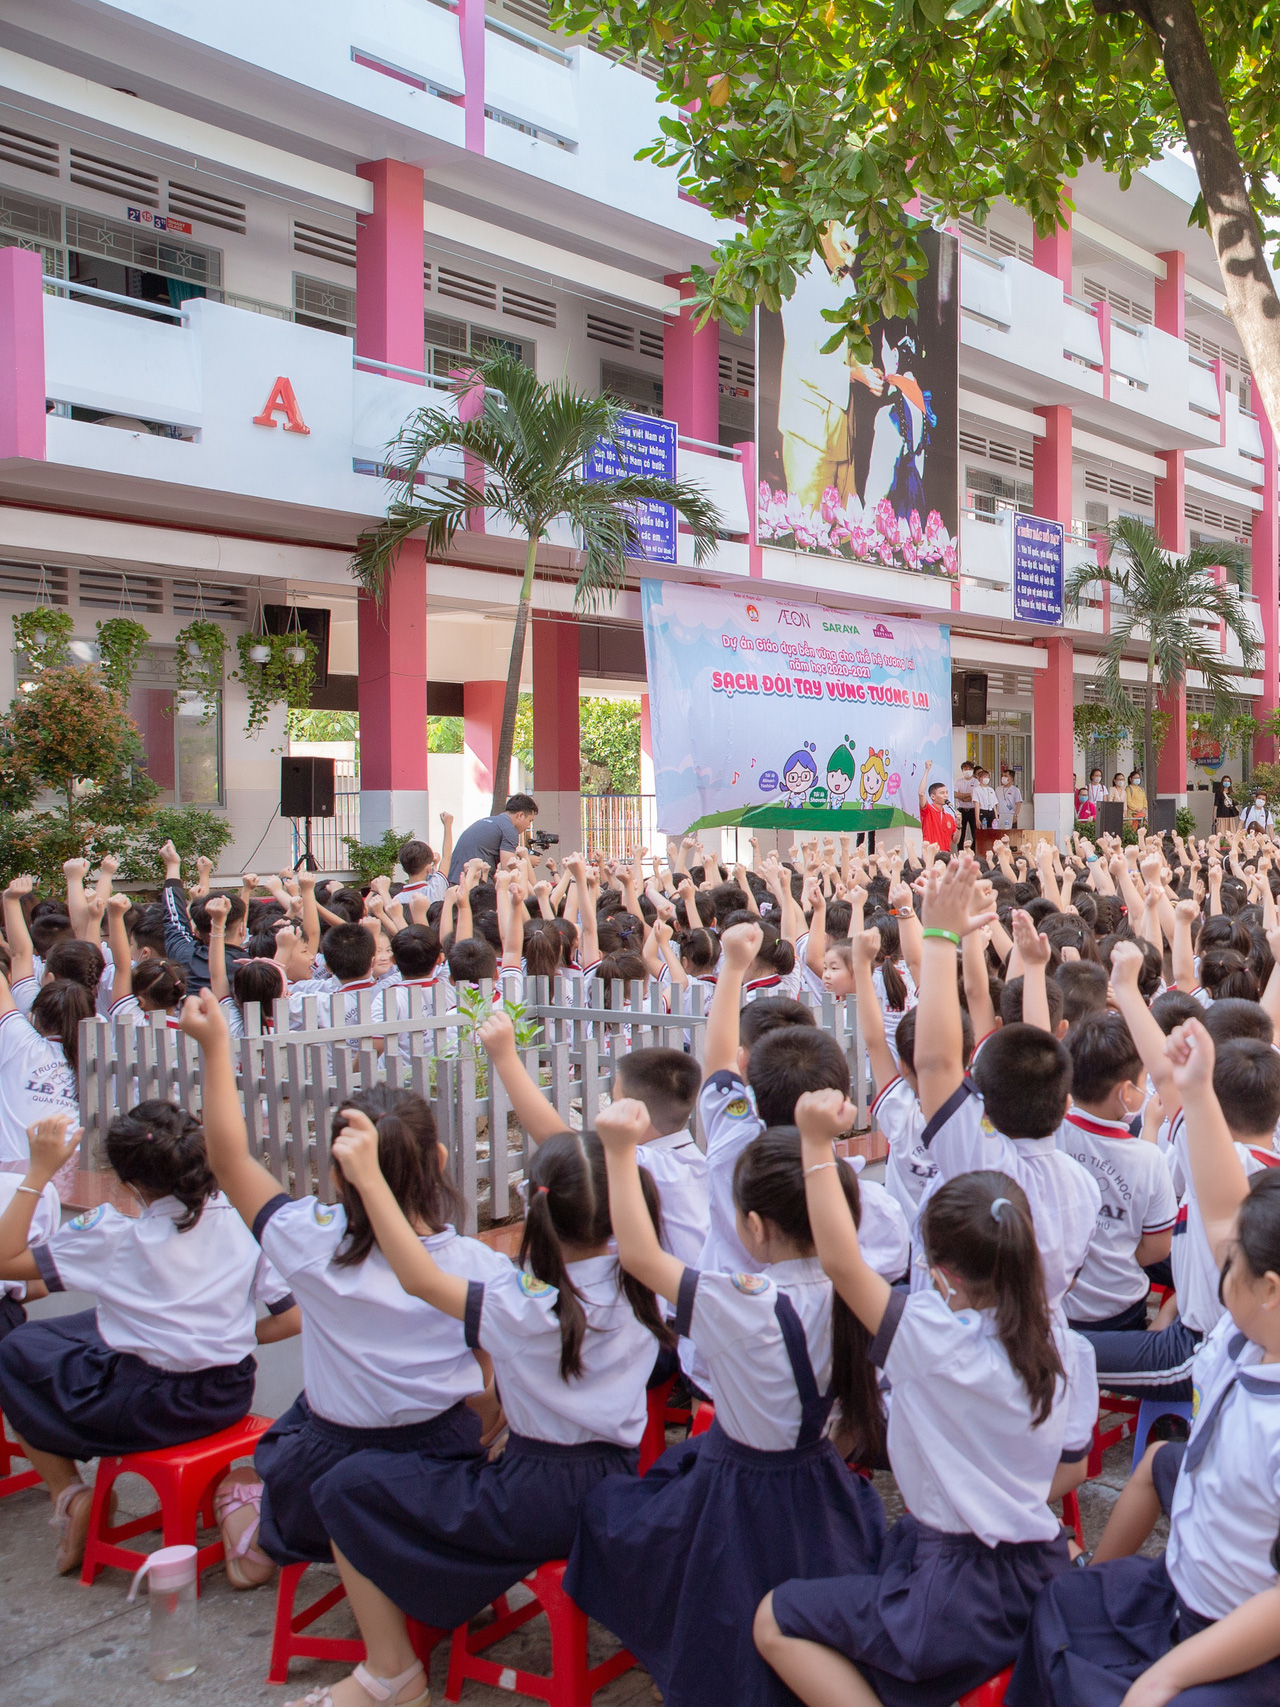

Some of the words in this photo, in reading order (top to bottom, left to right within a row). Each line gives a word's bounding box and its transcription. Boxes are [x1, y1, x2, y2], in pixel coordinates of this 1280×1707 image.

[143, 212, 152, 222] 15
[253, 376, 310, 435] A
[822, 621, 860, 635] SARAYA
[722, 634, 738, 652] Dự
[740, 635, 754, 651] án
[755, 637, 779, 653] Giáo
[780, 640, 798, 657] dục
[798, 640, 815, 658] bền
[816, 646, 837, 663] vững
[838, 649, 855, 662] cho
[871, 652, 883, 668] hệ
[883, 654, 906, 671] tương
[906, 657, 915, 670] lai
[789, 659, 809, 673] năm
[810, 661, 828, 676] học
[827, 663, 871, 679] 2020-2021
[712, 671, 758, 695] SẠCH
[762, 673, 792, 694] ĐÔI
[793, 677, 822, 696] TAY
[826, 679, 866, 700] VỮNG
[867, 684, 910, 706] TƯƠNG
[911, 690, 929, 708] LAI
[25, 1080, 55, 1095] LÊ
[1090, 1155, 1116, 1178] TIỂU
[1114, 1175, 1133, 1201] HỌC
[1098, 1204, 1129, 1221] AI
